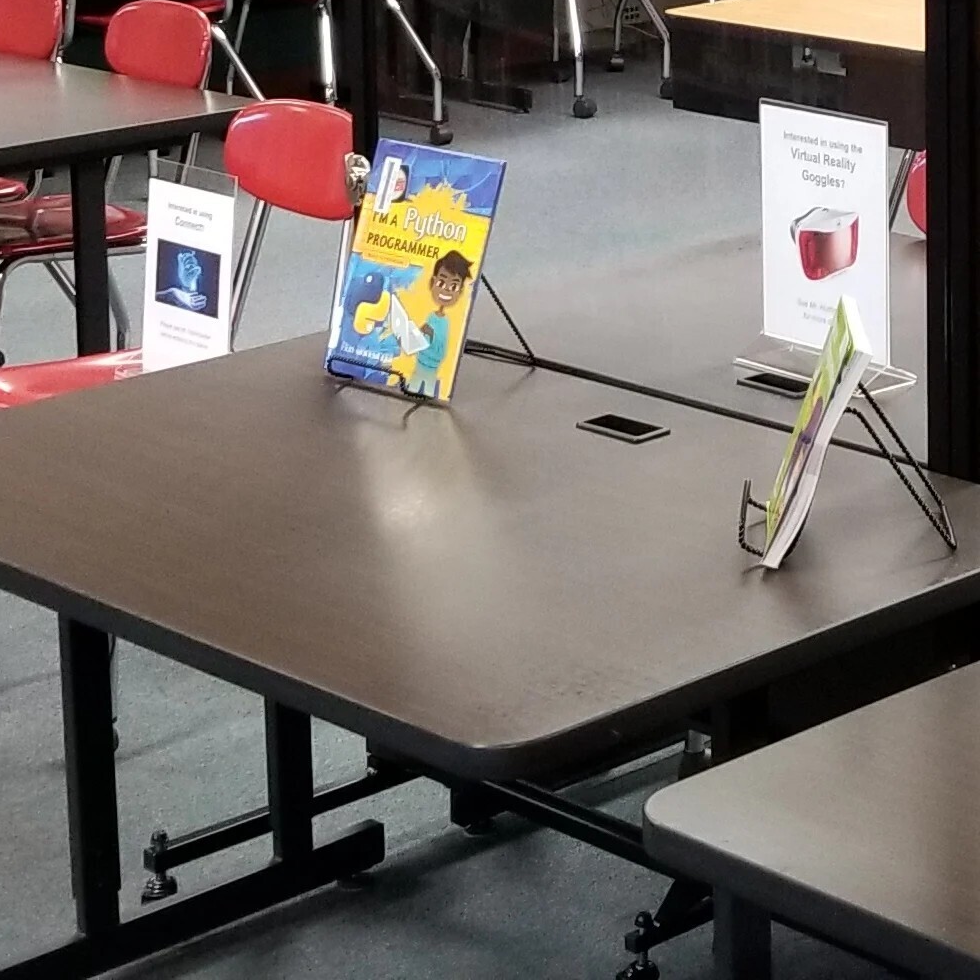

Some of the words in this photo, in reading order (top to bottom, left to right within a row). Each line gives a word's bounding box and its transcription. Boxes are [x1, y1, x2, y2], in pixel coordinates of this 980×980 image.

[783, 130, 819, 146] Interested
[820, 138, 828, 147] in
[829, 139, 849, 154] using
[851, 143, 863, 154] the
[791, 147, 821, 164] Virtual
[823, 153, 856, 174] Reality
[802, 169, 846, 188] Goggles?
[389, 214, 398, 226] A
[403, 207, 467, 243] Python
[367, 232, 440, 259] PROGRAMMER
